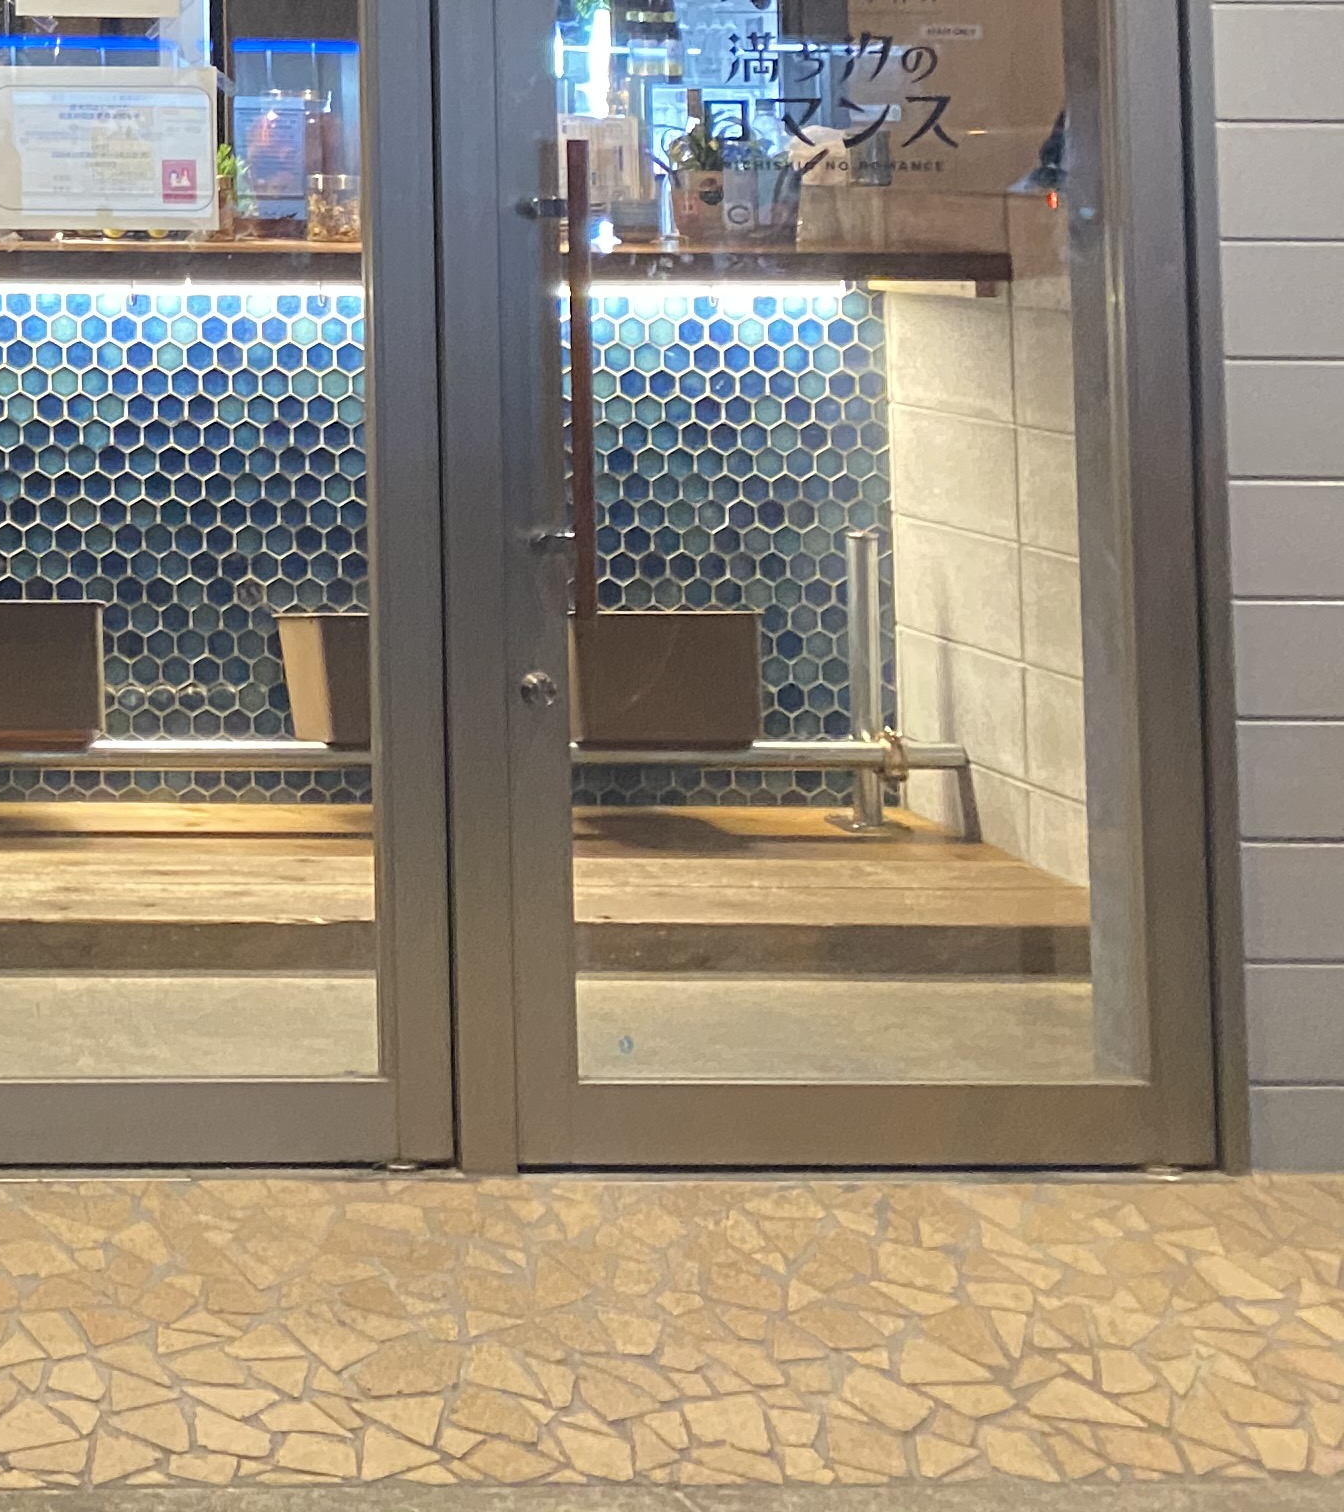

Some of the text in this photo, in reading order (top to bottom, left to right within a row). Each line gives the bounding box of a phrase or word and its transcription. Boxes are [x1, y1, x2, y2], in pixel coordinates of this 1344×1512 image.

[724, 30, 939, 84] 満ち汐の
[703, 95, 960, 149] ロマンス
[825, 161, 849, 172] NO
